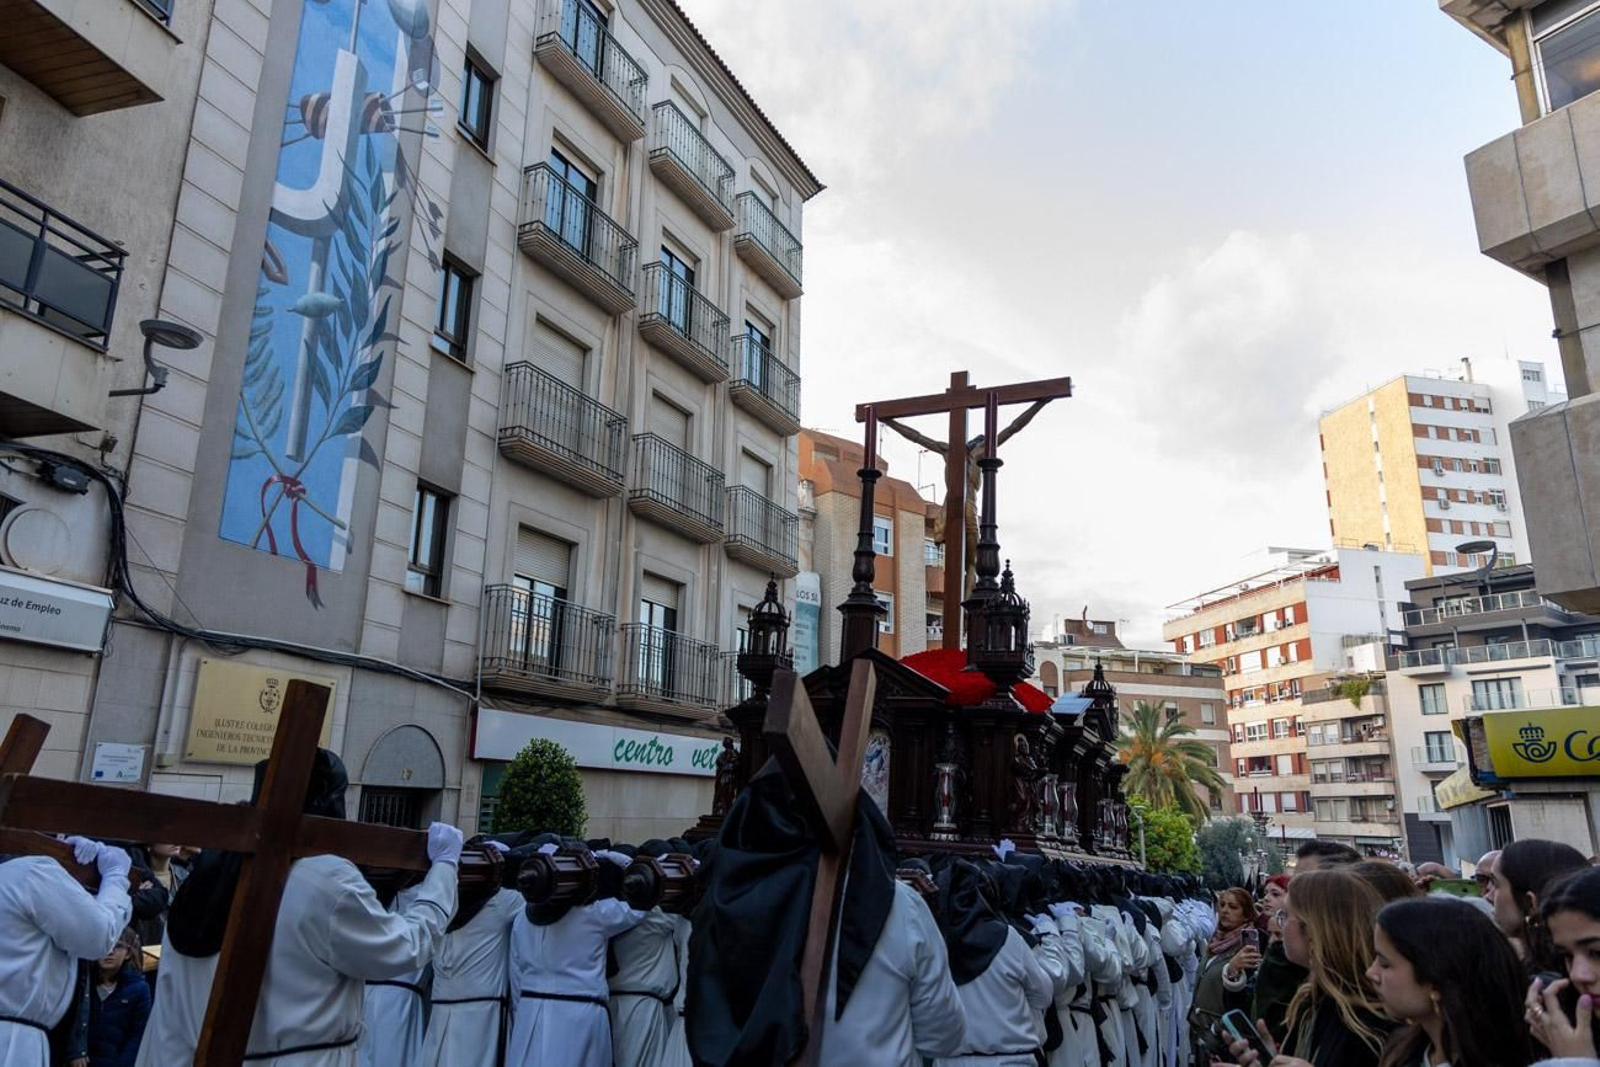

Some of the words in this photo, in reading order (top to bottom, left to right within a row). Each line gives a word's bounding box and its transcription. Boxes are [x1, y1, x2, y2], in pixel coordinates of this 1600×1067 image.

[11, 597, 24, 608] de
[25, 600, 61, 615] Empleo
[215, 718, 245, 730] ILUSTRE
[196, 728, 242, 742] INGENIEROS
[243, 732, 273, 743] TECNICO
[216, 743, 227, 752] DE
[228, 745, 238, 754] LA
[239, 745, 272, 756] PROVINC
[613, 735, 674, 766] centro
[692, 743, 719, 770] vet
